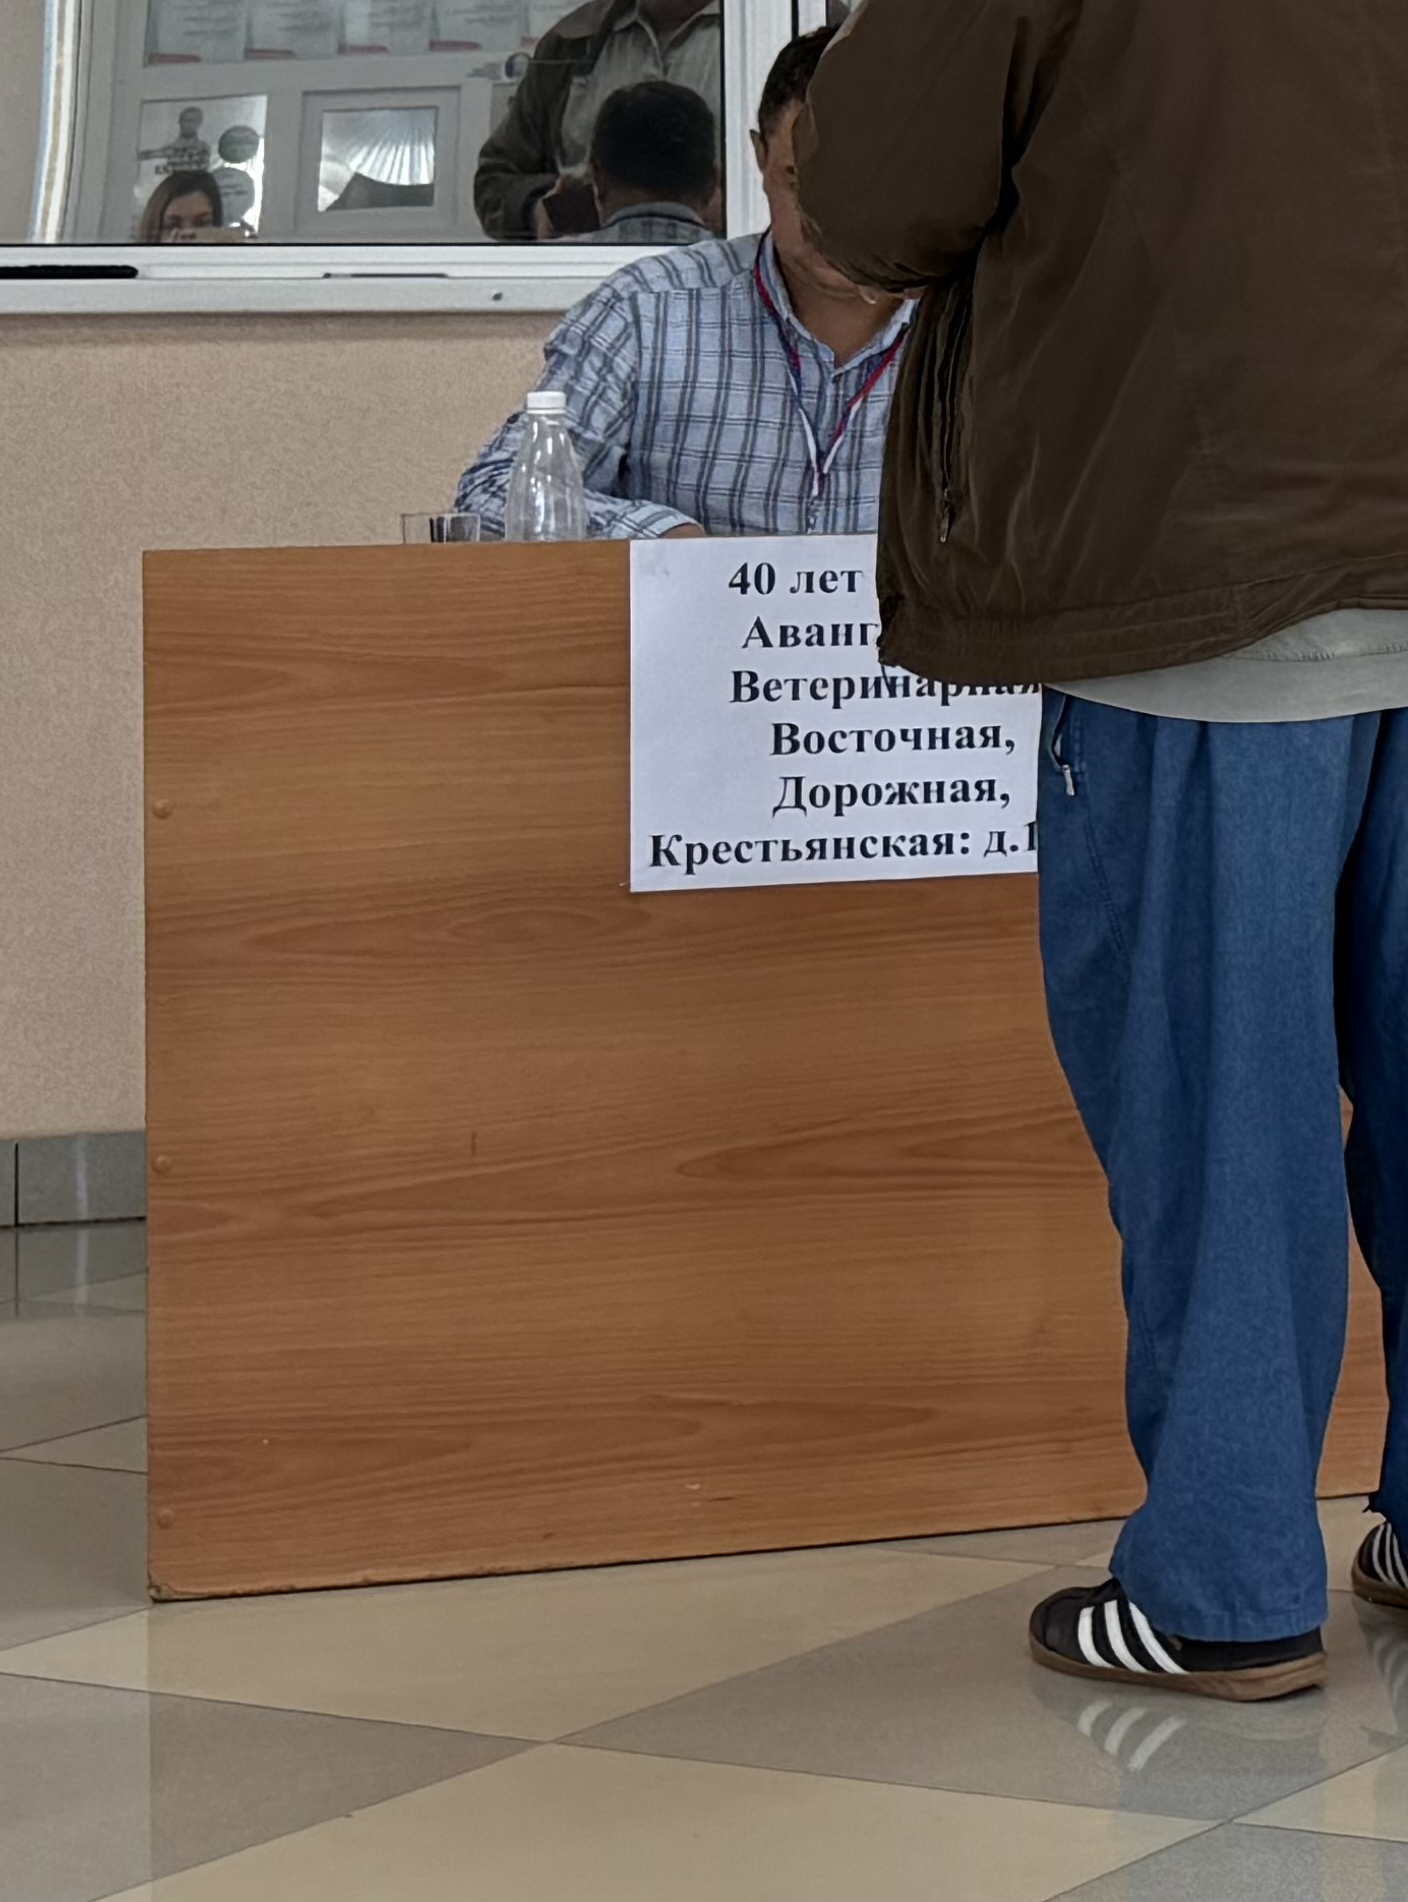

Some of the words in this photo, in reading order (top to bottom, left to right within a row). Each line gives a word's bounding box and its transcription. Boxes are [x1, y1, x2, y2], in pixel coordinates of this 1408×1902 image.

[728, 562, 776, 596] 40
[789, 570, 863, 594] лет
[741, 616, 878, 649] Аванг
[770, 722, 1015, 756] Восточная,
[772, 775, 1010, 818] Дорожная,
[649, 832, 970, 876] Крестьянская:
[983, 820, 1038, 858] д.1
